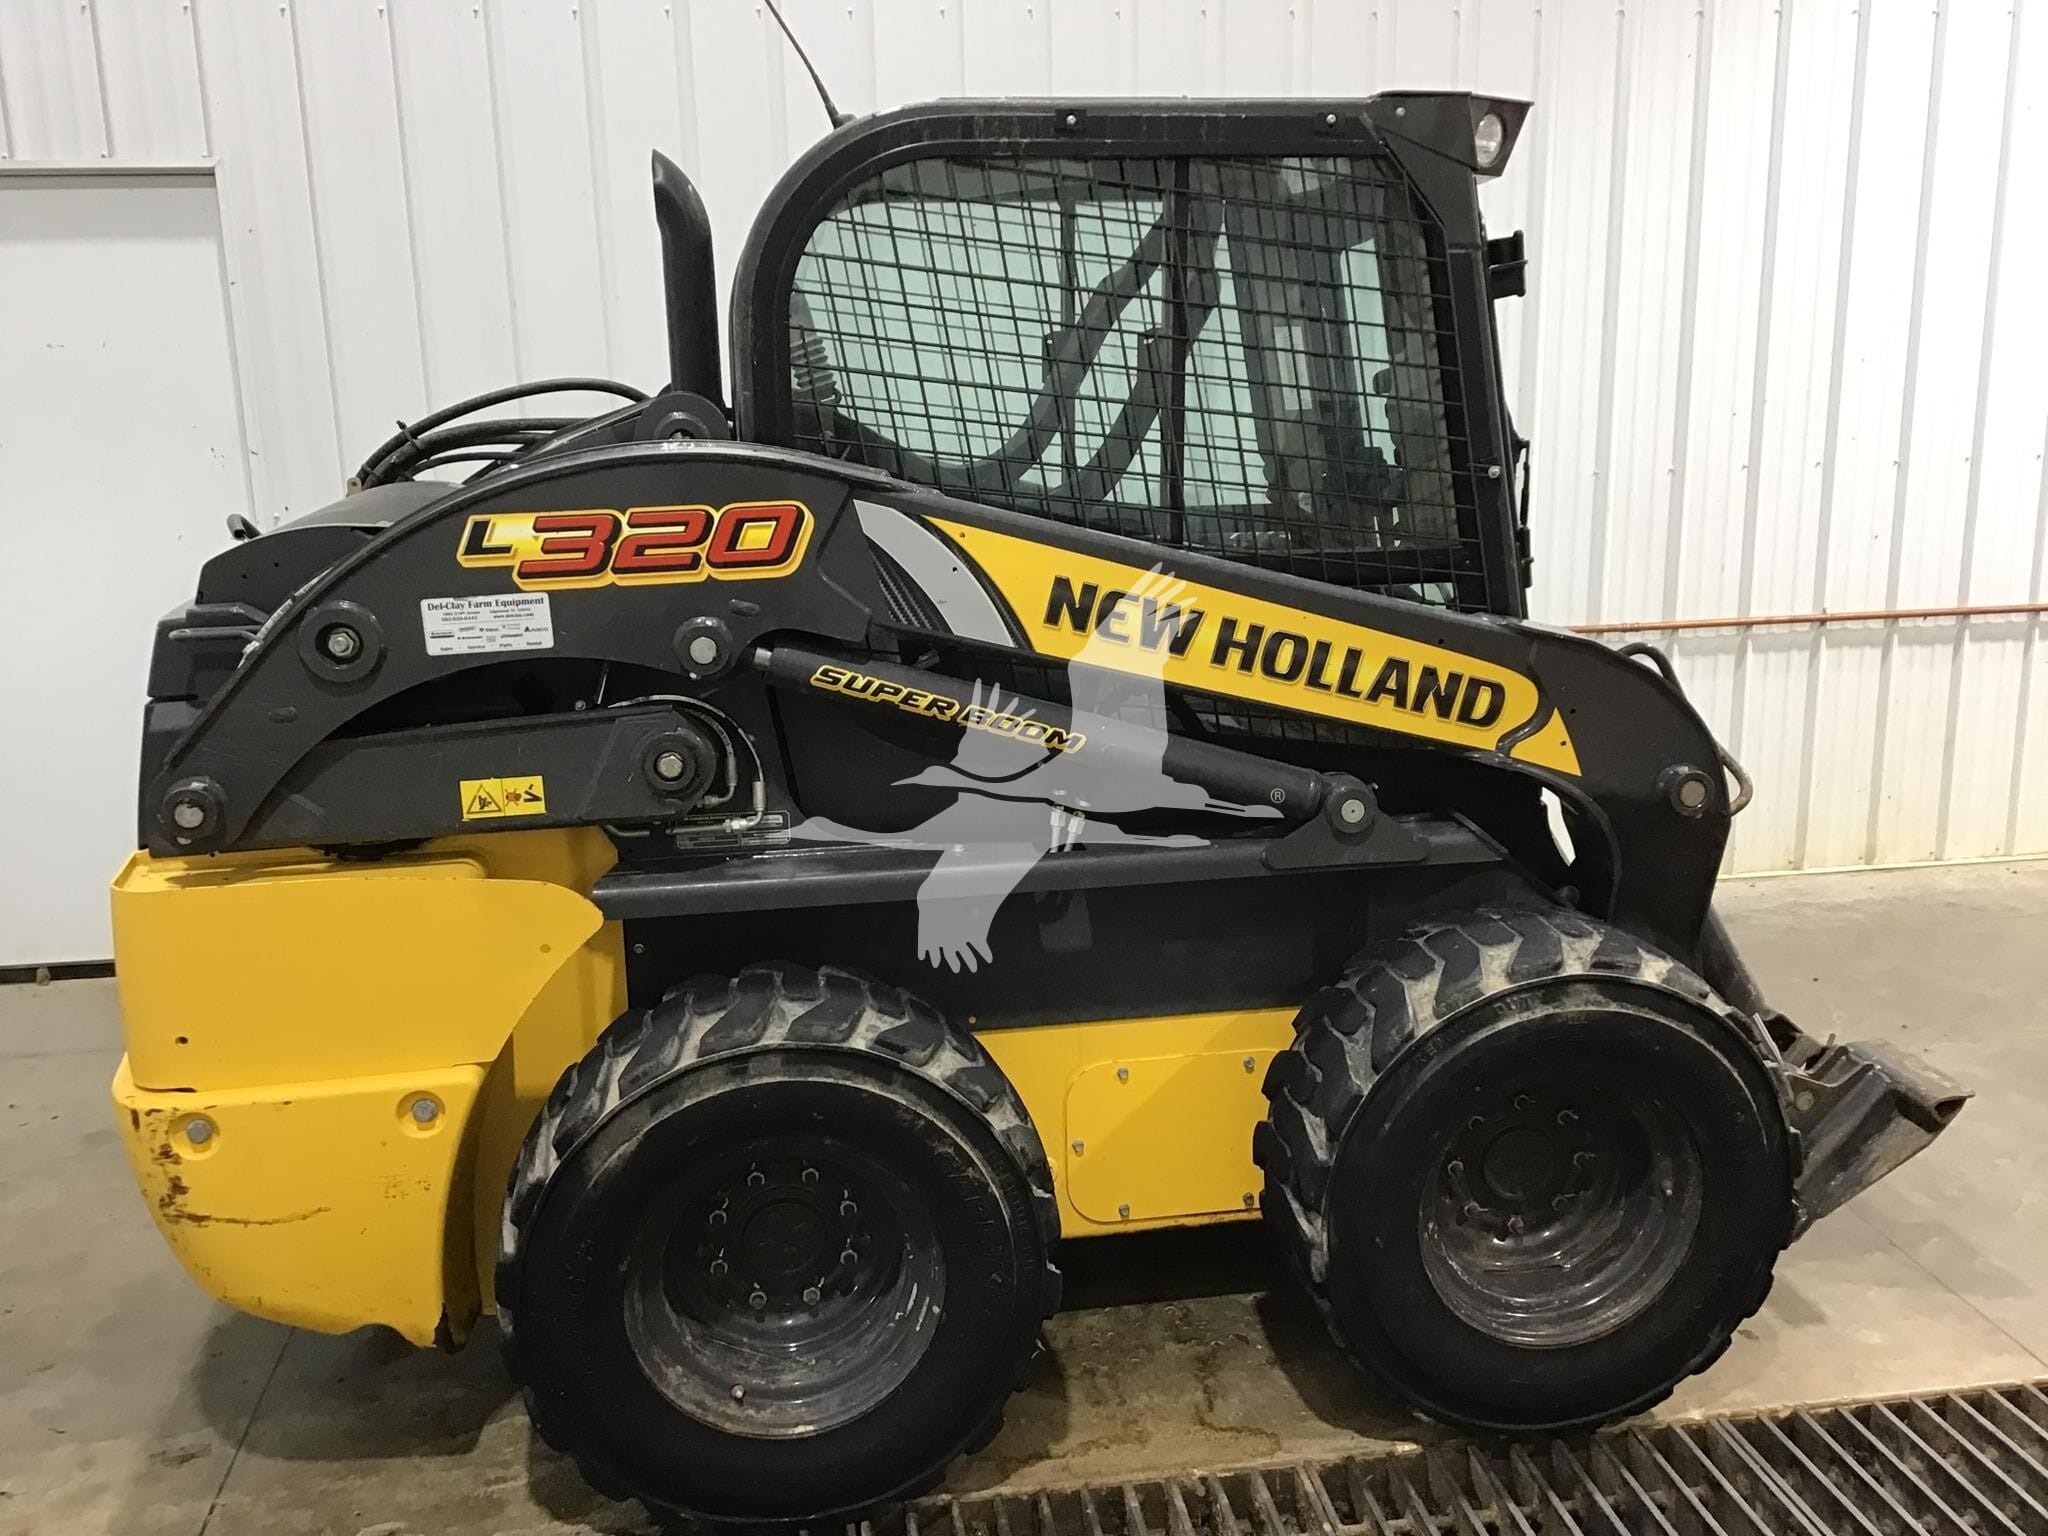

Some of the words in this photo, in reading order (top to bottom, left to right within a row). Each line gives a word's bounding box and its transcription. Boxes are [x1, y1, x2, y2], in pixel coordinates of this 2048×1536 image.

[456, 500, 814, 591] L320
[427, 601, 465, 611] Del-Clay
[468, 600, 492, 609] Farm
[495, 597, 544, 608] Equipment
[1043, 574, 1206, 658] NEW
[1209, 615, 1508, 729] HOLLAND
[810, 664, 959, 721] SUPER
[957, 704, 1086, 753] BOOM
